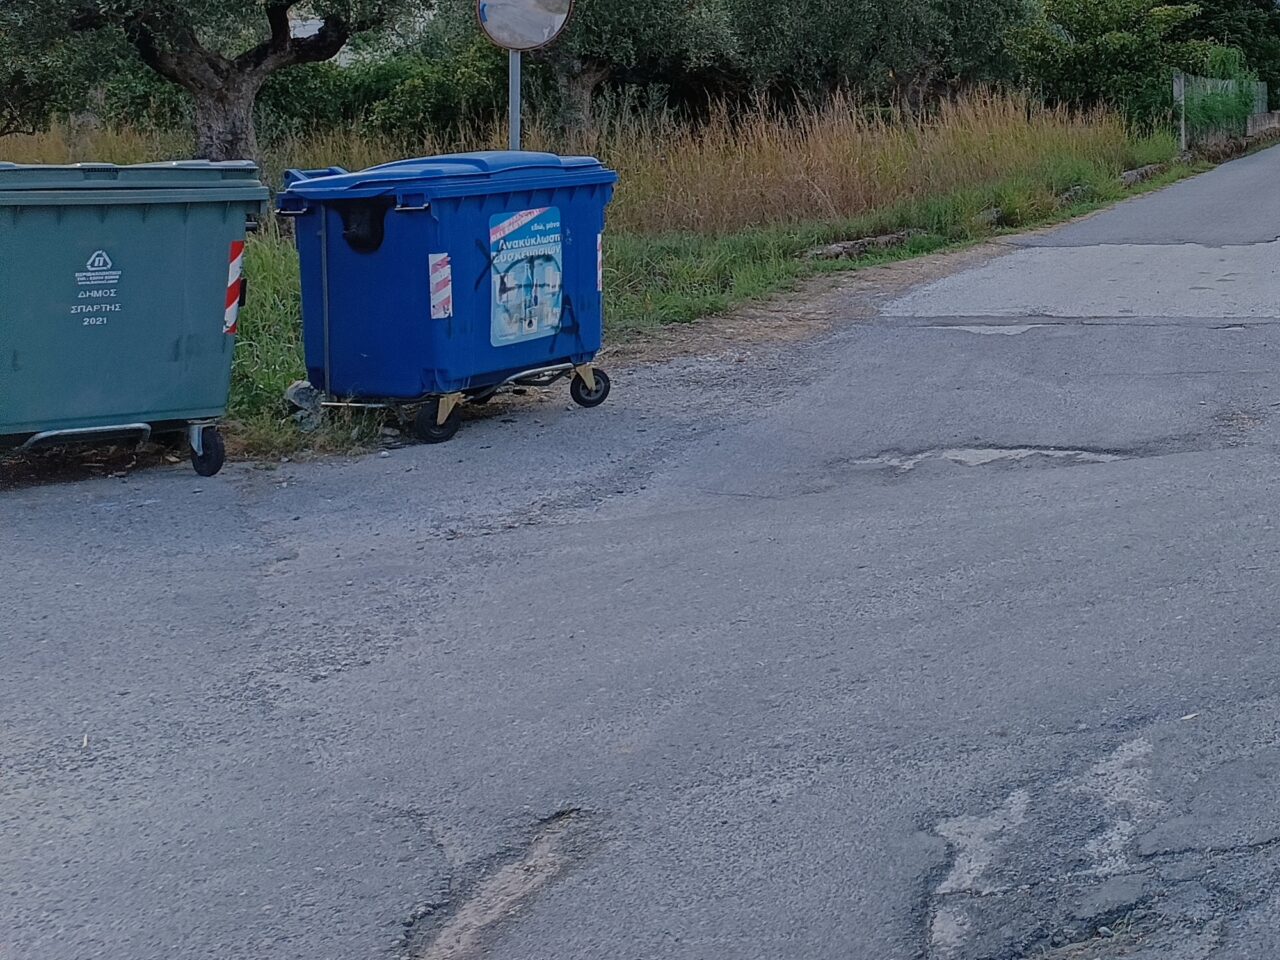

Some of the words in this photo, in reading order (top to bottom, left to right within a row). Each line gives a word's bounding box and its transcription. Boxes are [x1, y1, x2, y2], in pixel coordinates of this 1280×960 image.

[499, 233, 561, 250] Ανακύκλωση
[78, 289, 117, 298] ΔΗΜΟΣ
[70, 303, 122, 314] ΣΠΑΡΤΗΣ
[82, 316, 107, 326] 2021
